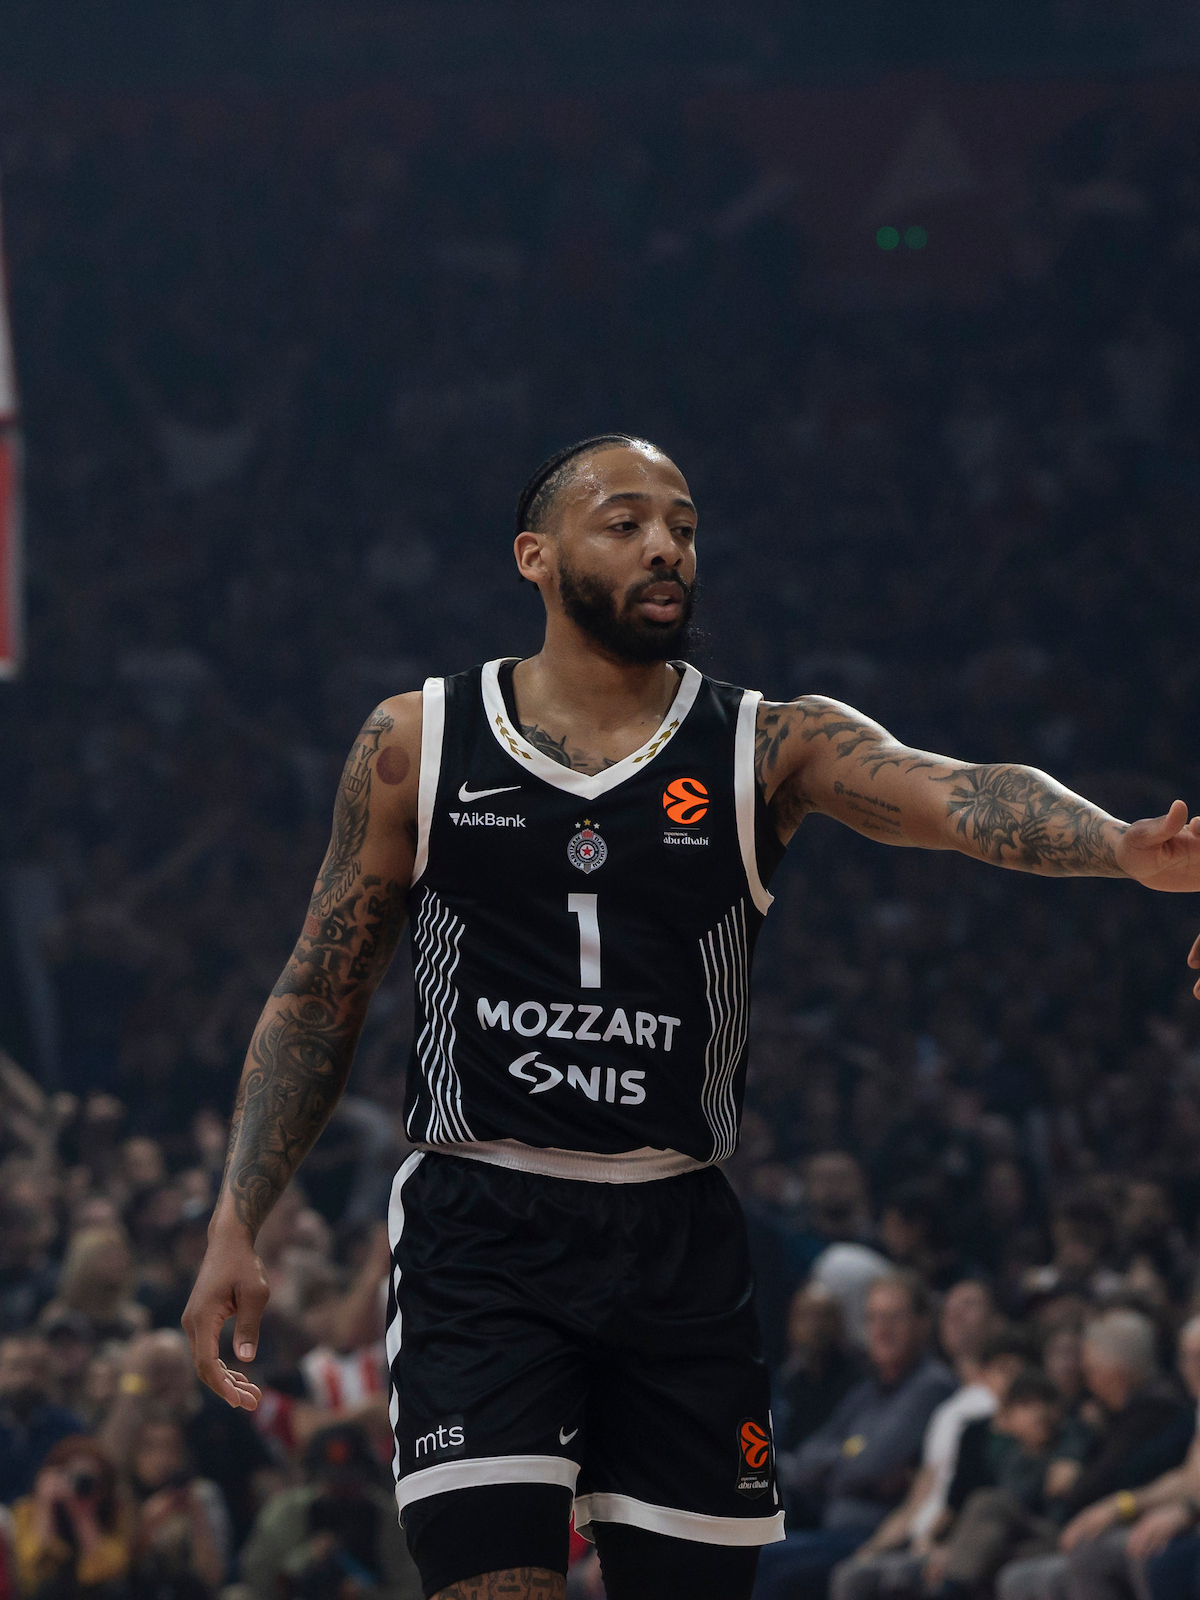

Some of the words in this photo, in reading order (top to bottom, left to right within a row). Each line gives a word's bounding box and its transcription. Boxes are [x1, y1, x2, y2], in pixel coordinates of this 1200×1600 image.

[460, 812, 527, 828] AikBank
[663, 837, 680, 845] abu
[681, 837, 709, 846] dhabi
[567, 894, 601, 988] 1
[476, 997, 682, 1052] MOZZART
[567, 1065, 647, 1106] NIS
[415, 1424, 466, 1458] mts
